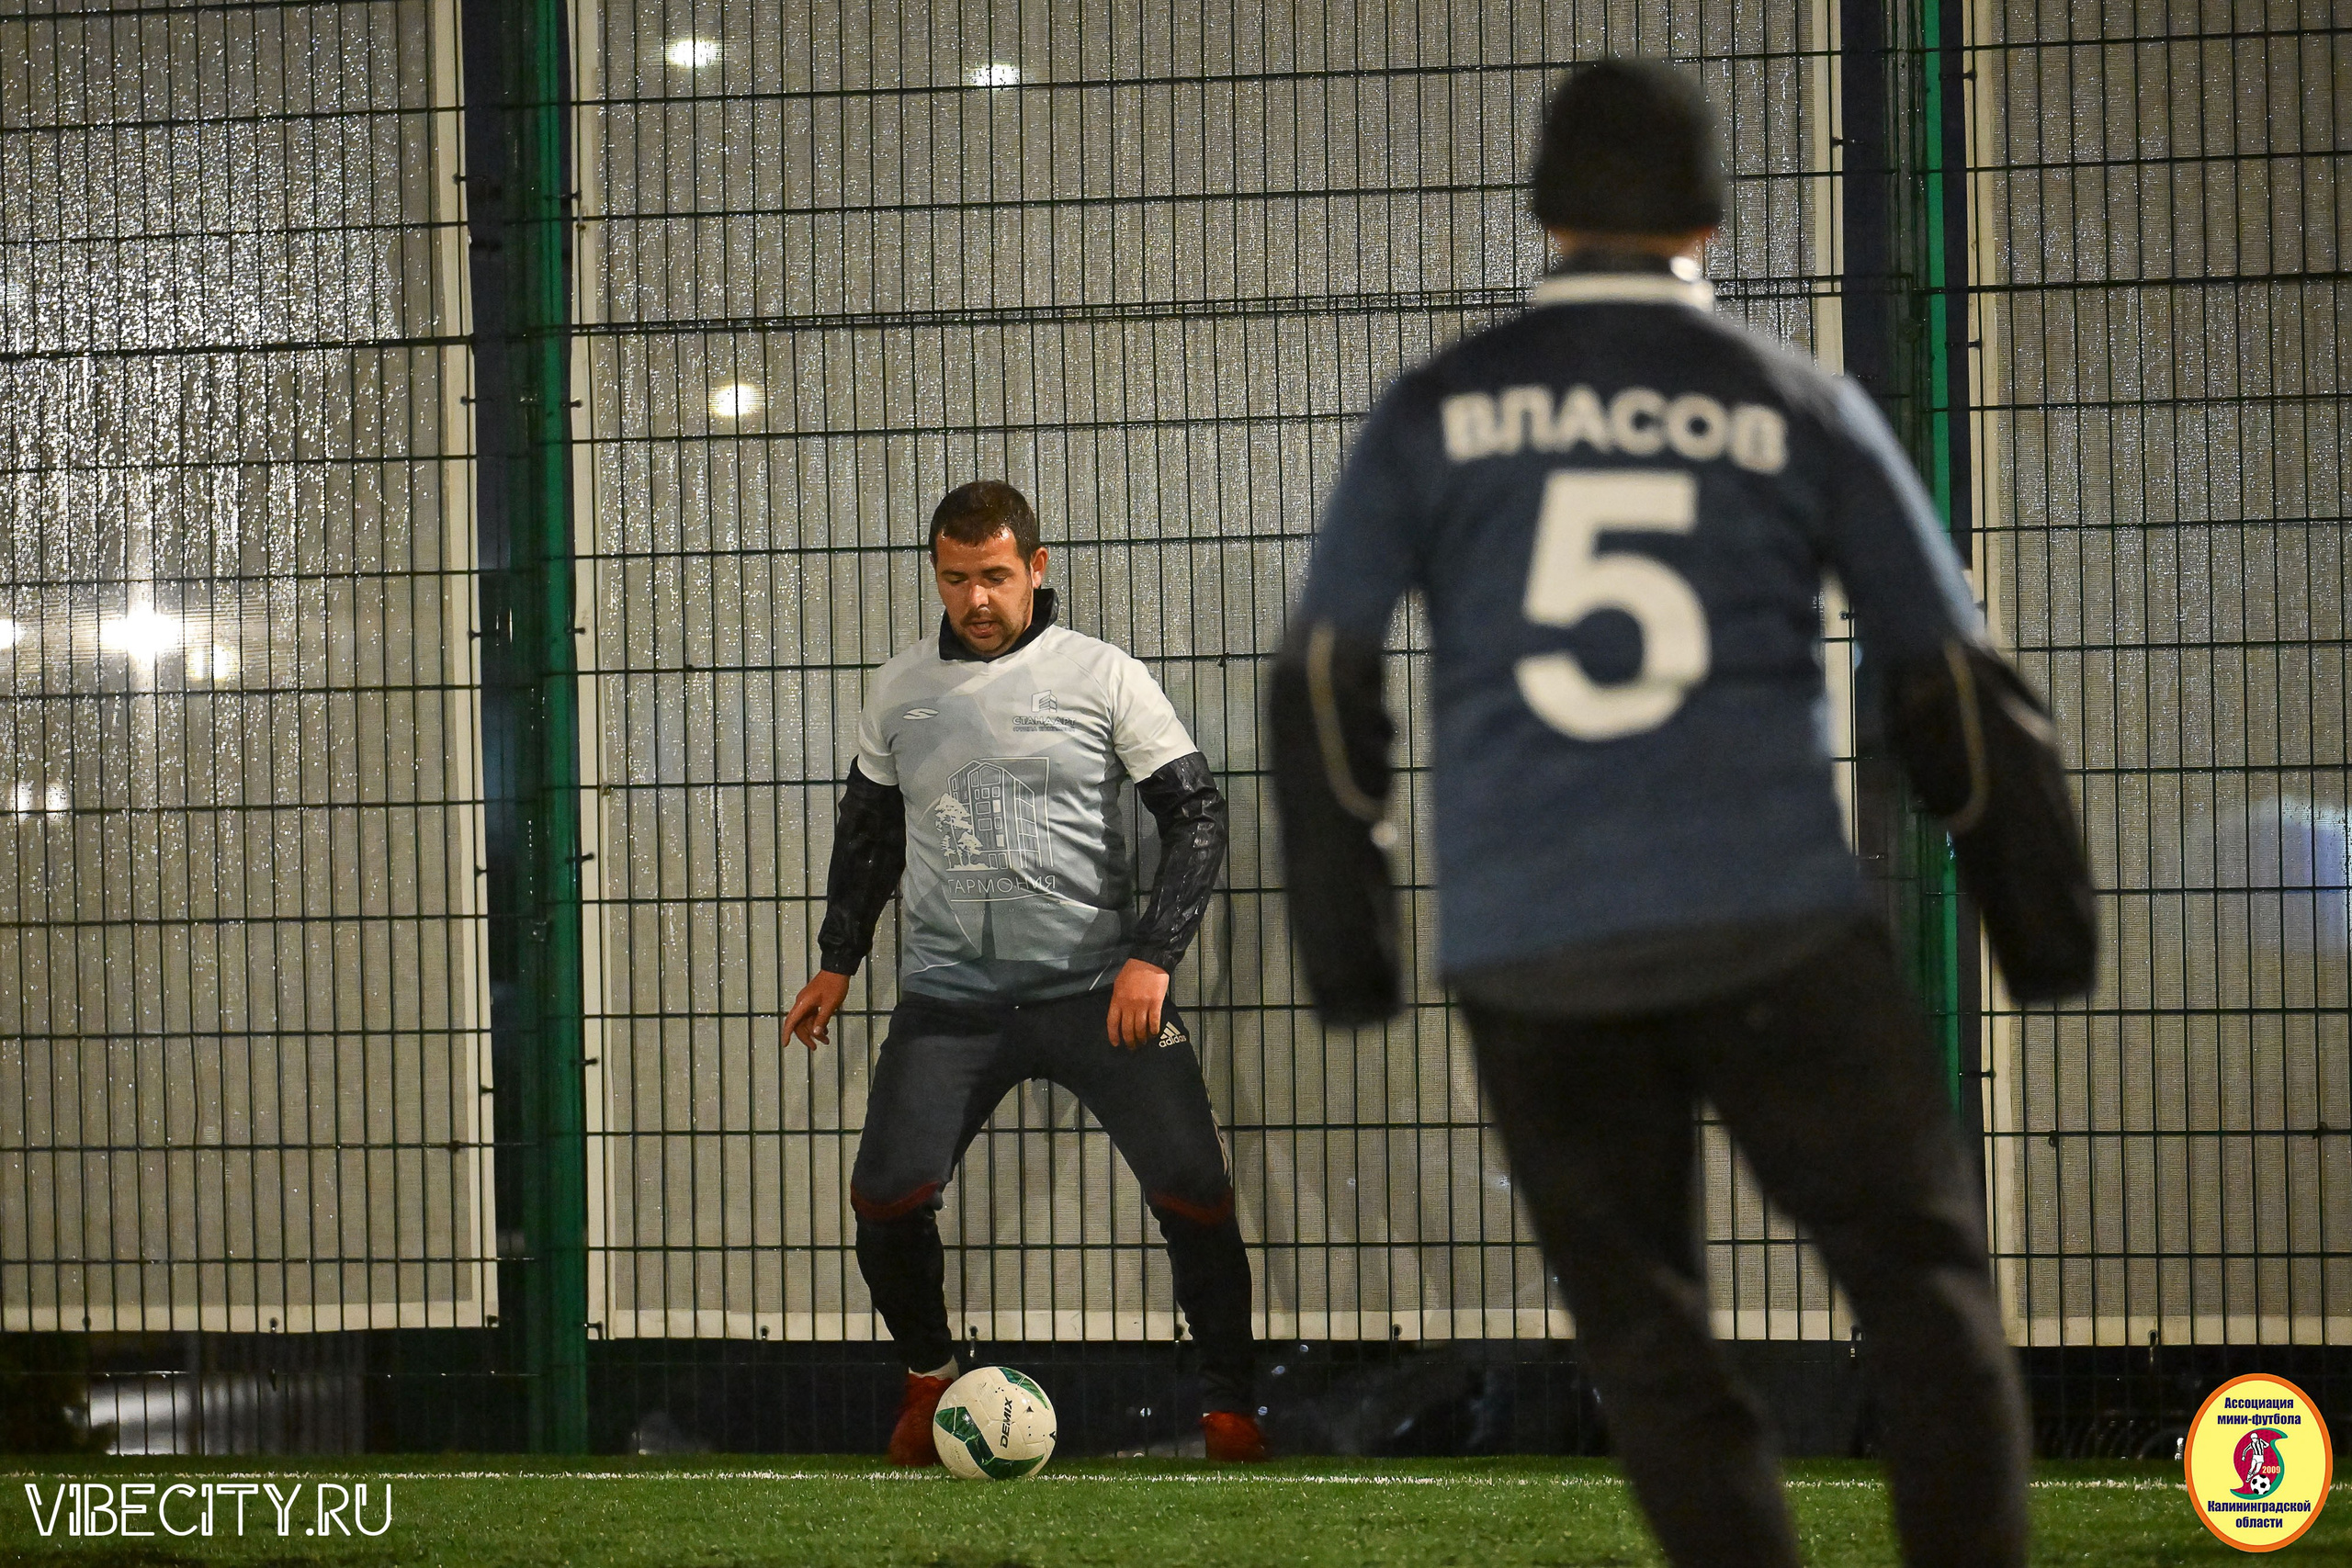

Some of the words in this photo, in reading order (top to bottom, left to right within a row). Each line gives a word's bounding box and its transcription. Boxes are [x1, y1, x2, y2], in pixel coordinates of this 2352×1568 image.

[1441, 383, 1788, 473] ВЛАСОВ
[1513, 468, 1711, 740] 5
[948, 874, 1056, 894] ГАРМОНИЯ
[1159, 1034, 1187, 1048] adidas
[1001, 1396, 1012, 1449] DEMIX
